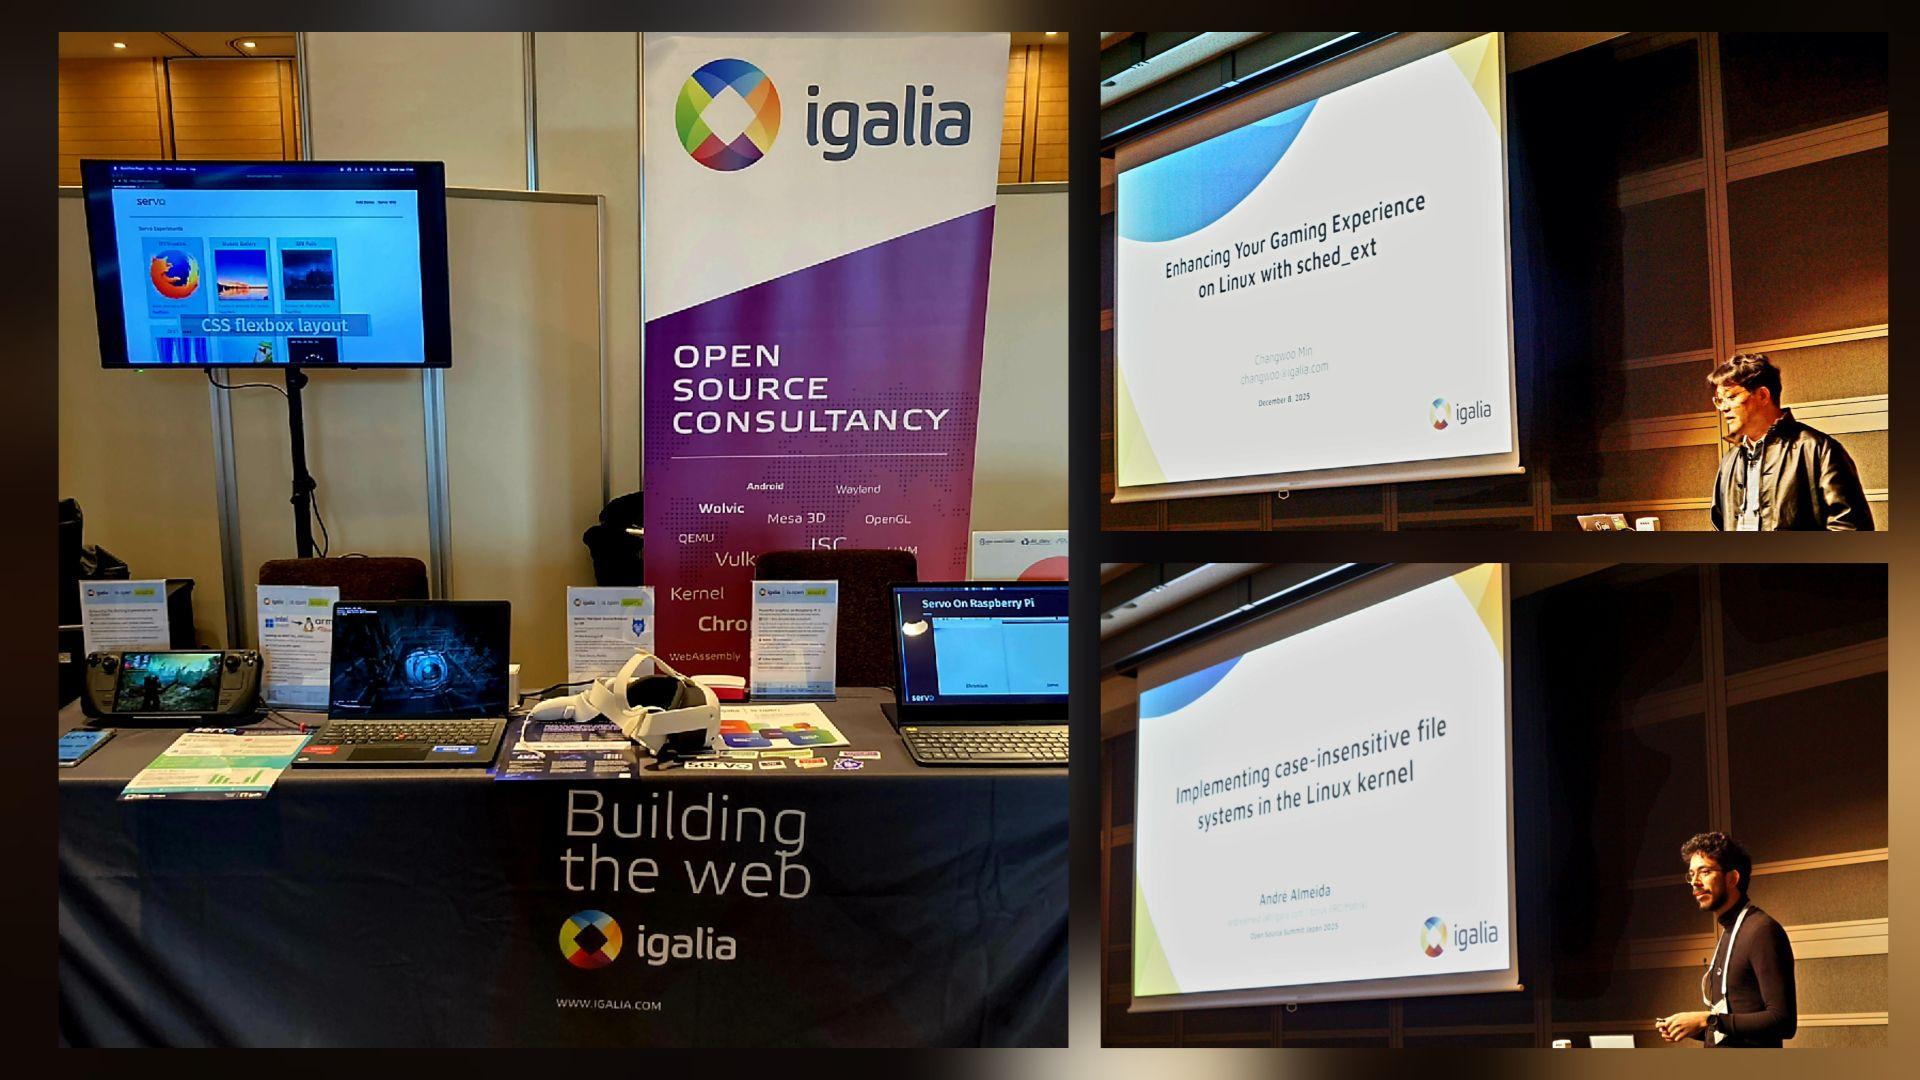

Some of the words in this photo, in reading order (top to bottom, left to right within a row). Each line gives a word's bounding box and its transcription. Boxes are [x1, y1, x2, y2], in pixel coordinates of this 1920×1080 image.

[807, 84, 972, 162] igalia
[136, 198, 166, 206] servo
[1166, 248, 1230, 279] Enhancing
[1235, 238, 1266, 263] Your
[1270, 222, 1327, 250] Gaming
[1332, 194, 1426, 234] Experience
[1198, 282, 1215, 298] on
[1219, 270, 1256, 294] Linux
[1260, 259, 1292, 283] with
[1297, 238, 1377, 275] sched_ext
[202, 318, 230, 332] CSS
[236, 318, 294, 332] flexbox
[299, 318, 348, 335] layout
[673, 344, 780, 369] OPEN
[1254, 350, 1296, 366] Changwoo
[1298, 346, 1313, 358] Min
[672, 377, 828, 402] SOURCE
[1258, 397, 1286, 407] December
[1295, 392, 1311, 402] 2025
[1456, 400, 1492, 425] igalia
[672, 408, 950, 435] CONSULTANCY
[746, 482, 784, 491] Android
[836, 484, 881, 496] Wayland
[698, 502, 745, 514] Wolvic
[768, 514, 803, 524] Mesa
[807, 512, 826, 524] 3D
[865, 514, 911, 526] OpenGL
[678, 533, 715, 544] QEMU
[715, 551, 758, 567] Vulk
[670, 587, 724, 601] Kernel
[922, 599, 952, 609] Servo
[953, 599, 968, 608] On
[970, 598, 1022, 610] Raspberry
[1024, 598, 1035, 608] Pi
[698, 615, 748, 632] Chro
[668, 652, 741, 661] WebAssembly
[912, 694, 935, 702] servo
[688, 762, 752, 770] servo
[1176, 766, 1270, 805] Implementing
[1274, 729, 1411, 779] case-insensitive
[1417, 716, 1448, 742] file
[1198, 800, 1254, 833] systems
[1258, 796, 1272, 816] in
[1276, 791, 1302, 813] the
[1306, 778, 1352, 805] Linux
[1357, 759, 1415, 793] kernel
[566, 789, 806, 858] Building
[560, 842, 660, 894] the
[683, 850, 811, 900] web
[1259, 891, 1288, 906] Andre
[1290, 884, 1332, 901] Almeida
[1453, 920, 1498, 952] igalia
[637, 924, 737, 966] igalia
[556, 998, 662, 1012] WWW.IGALIA.COM
